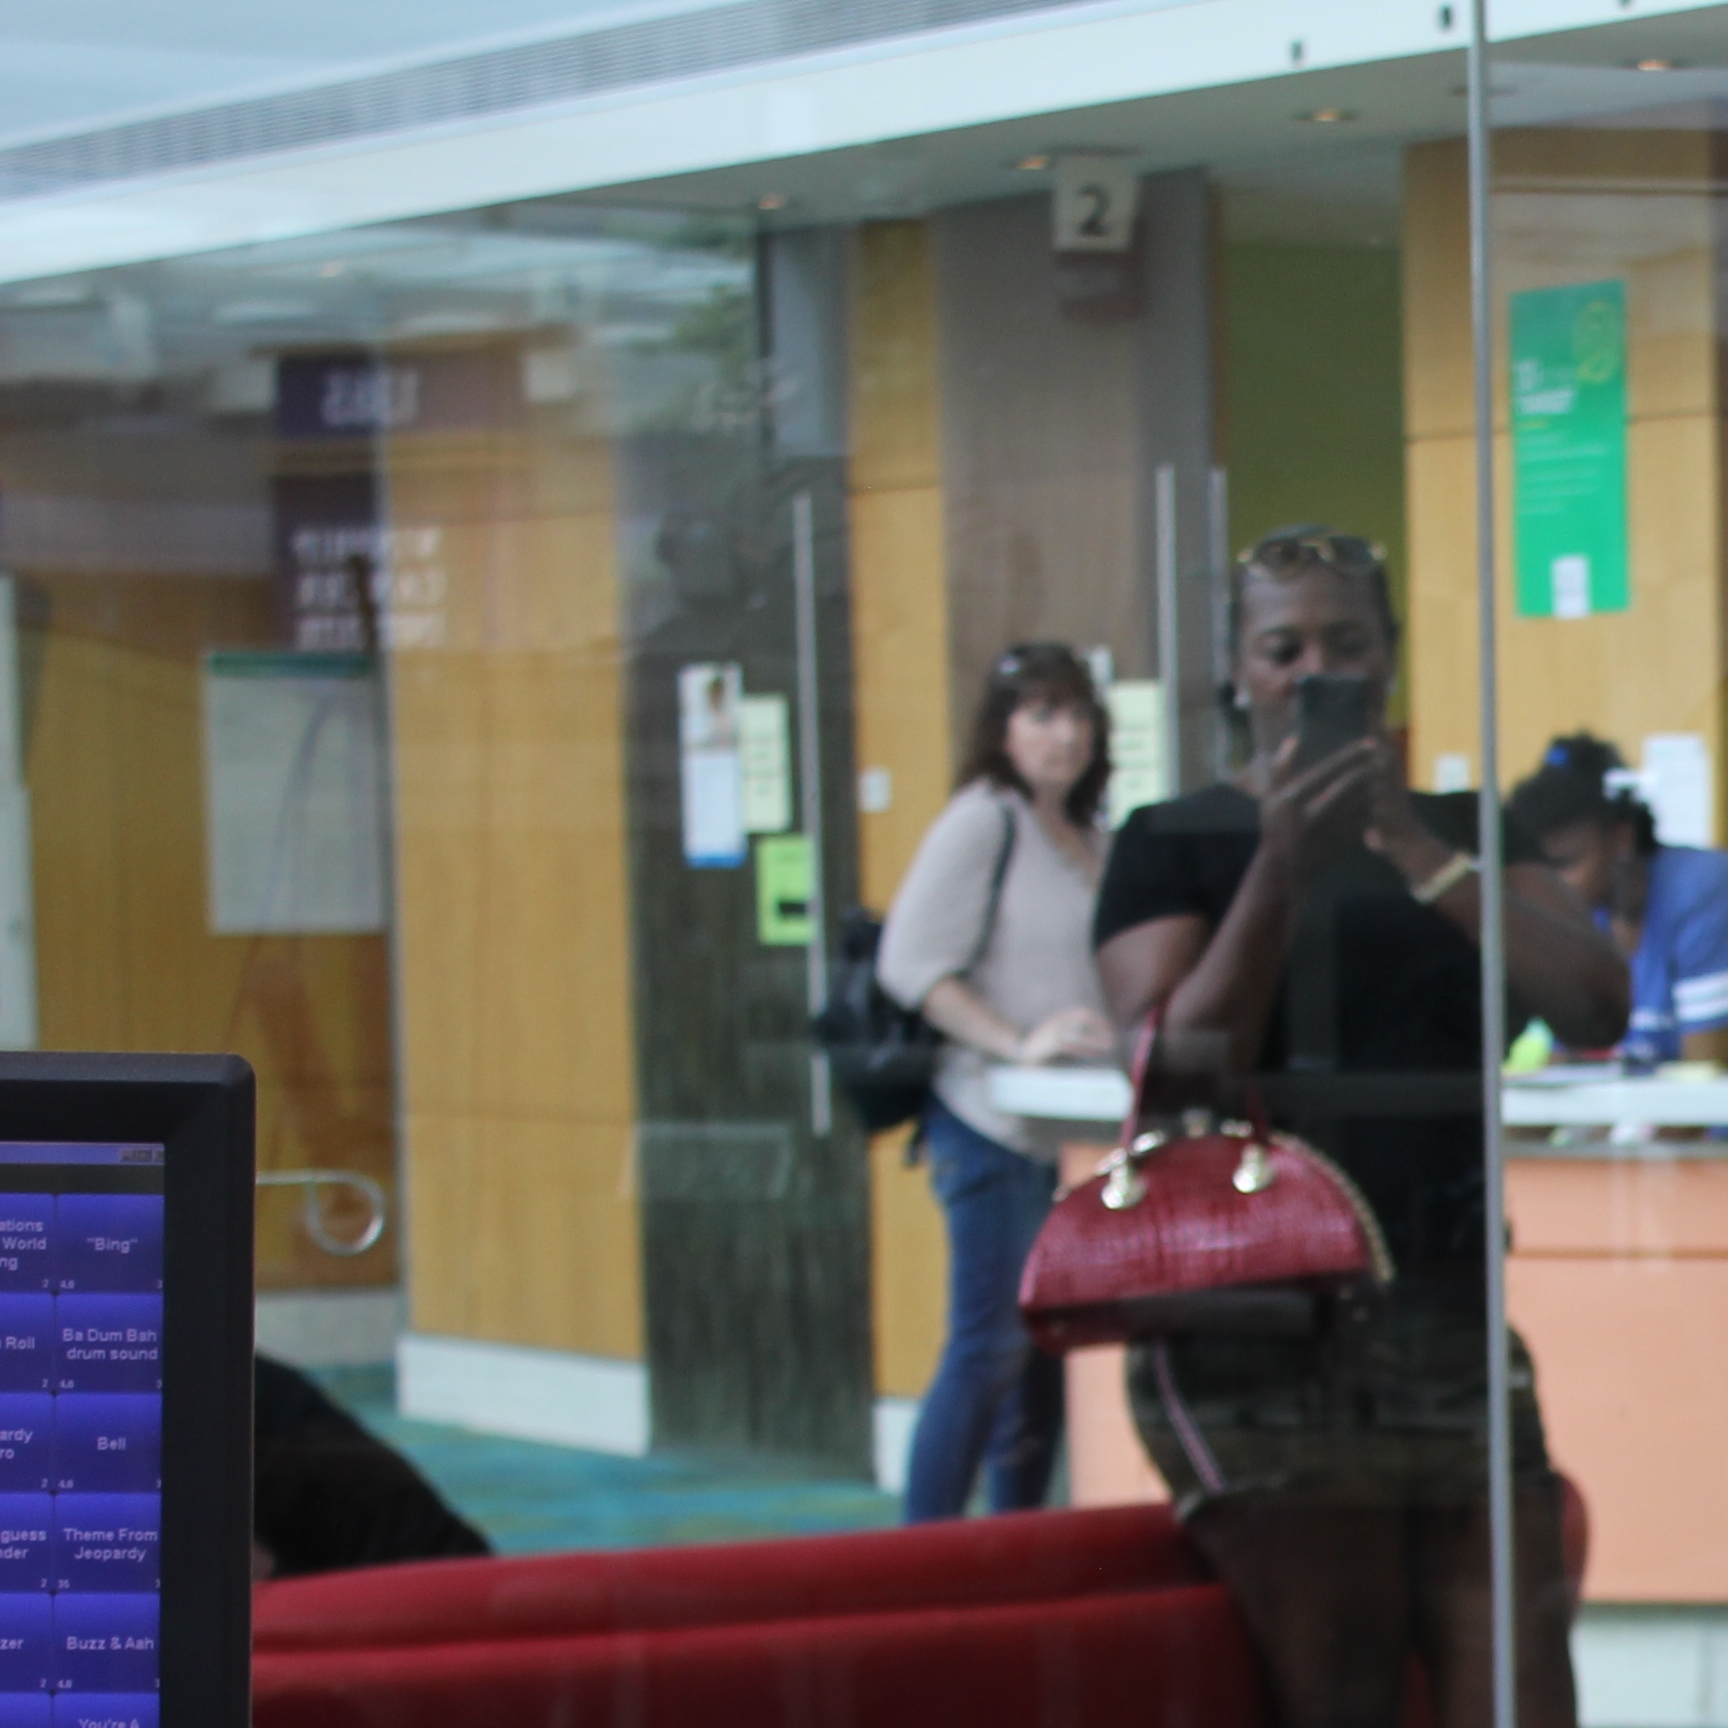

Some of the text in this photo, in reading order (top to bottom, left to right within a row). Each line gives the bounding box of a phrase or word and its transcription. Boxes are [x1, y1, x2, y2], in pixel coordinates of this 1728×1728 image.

[1077, 183, 1111, 235] 2
[2, 1238, 46, 1250] World
[62, 1328, 157, 1342] Ba Dum Bah
[6, 1337, 35, 1349] Roll
[66, 1348, 158, 1360] drum sound
[97, 1437, 126, 1450] Bell
[1, 1531, 47, 1543] guess
[63, 1528, 158, 1541] Theme From
[75, 1547, 147, 1562] Jeopardy
[66, 1637, 154, 1650] Buzz & Aah
